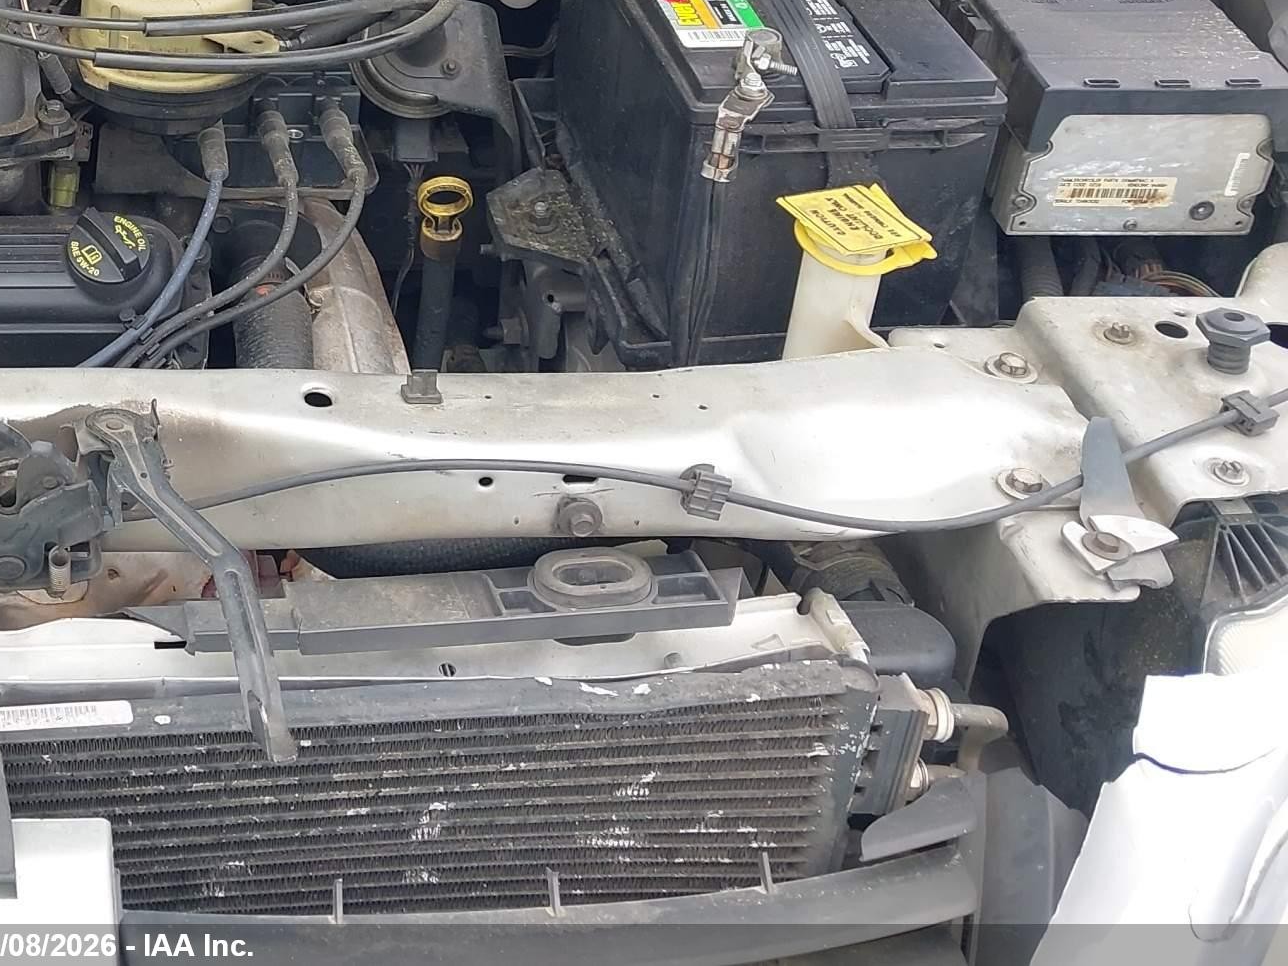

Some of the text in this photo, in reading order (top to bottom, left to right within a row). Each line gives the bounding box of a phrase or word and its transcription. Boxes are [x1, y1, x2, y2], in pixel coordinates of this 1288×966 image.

[114, 216, 146, 252] ENGINE OIL
[76, 256, 100, 276] 5W-20
